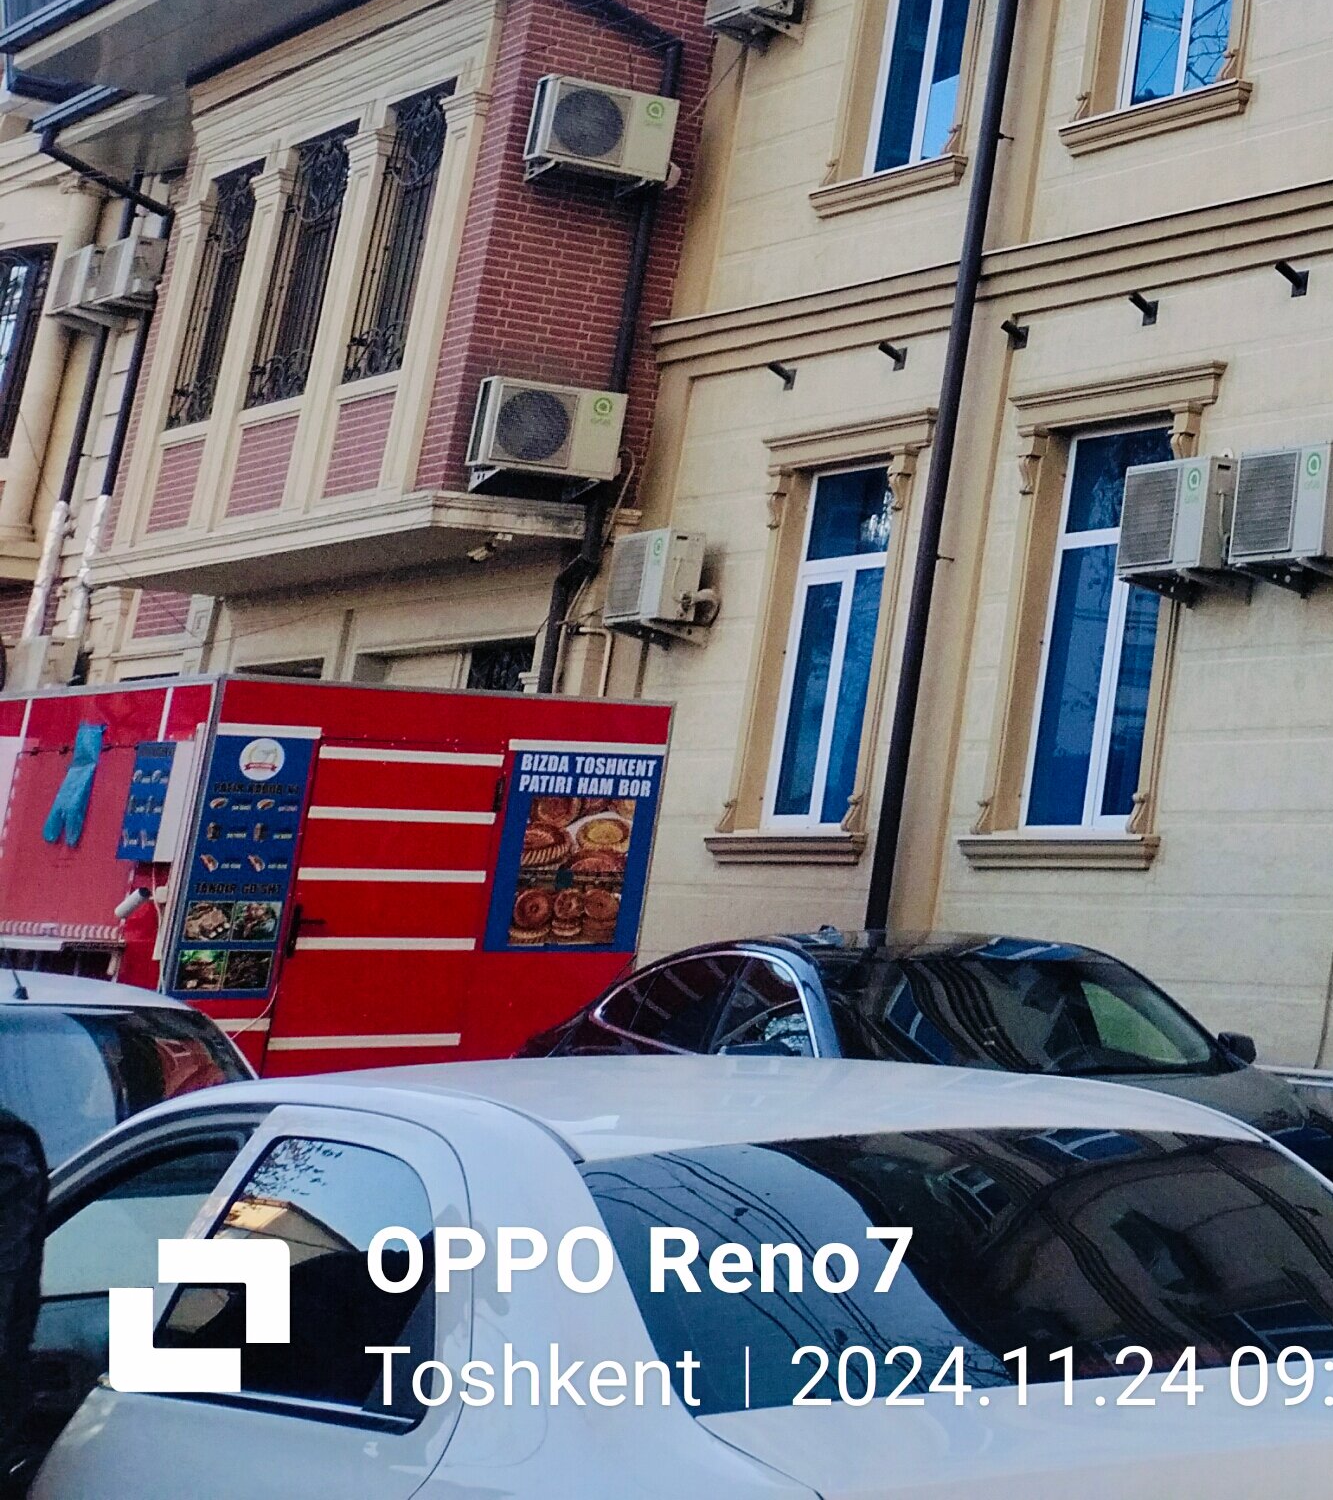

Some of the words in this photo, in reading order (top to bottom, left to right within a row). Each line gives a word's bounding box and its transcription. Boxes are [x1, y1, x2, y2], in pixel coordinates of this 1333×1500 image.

[521, 753, 569, 773] BIZDA
[575, 756, 657, 778] TOSHKENT
[518, 774, 573, 794] PATIRI
[577, 776, 614, 797] HAM
[618, 778, 652, 798] BOR
